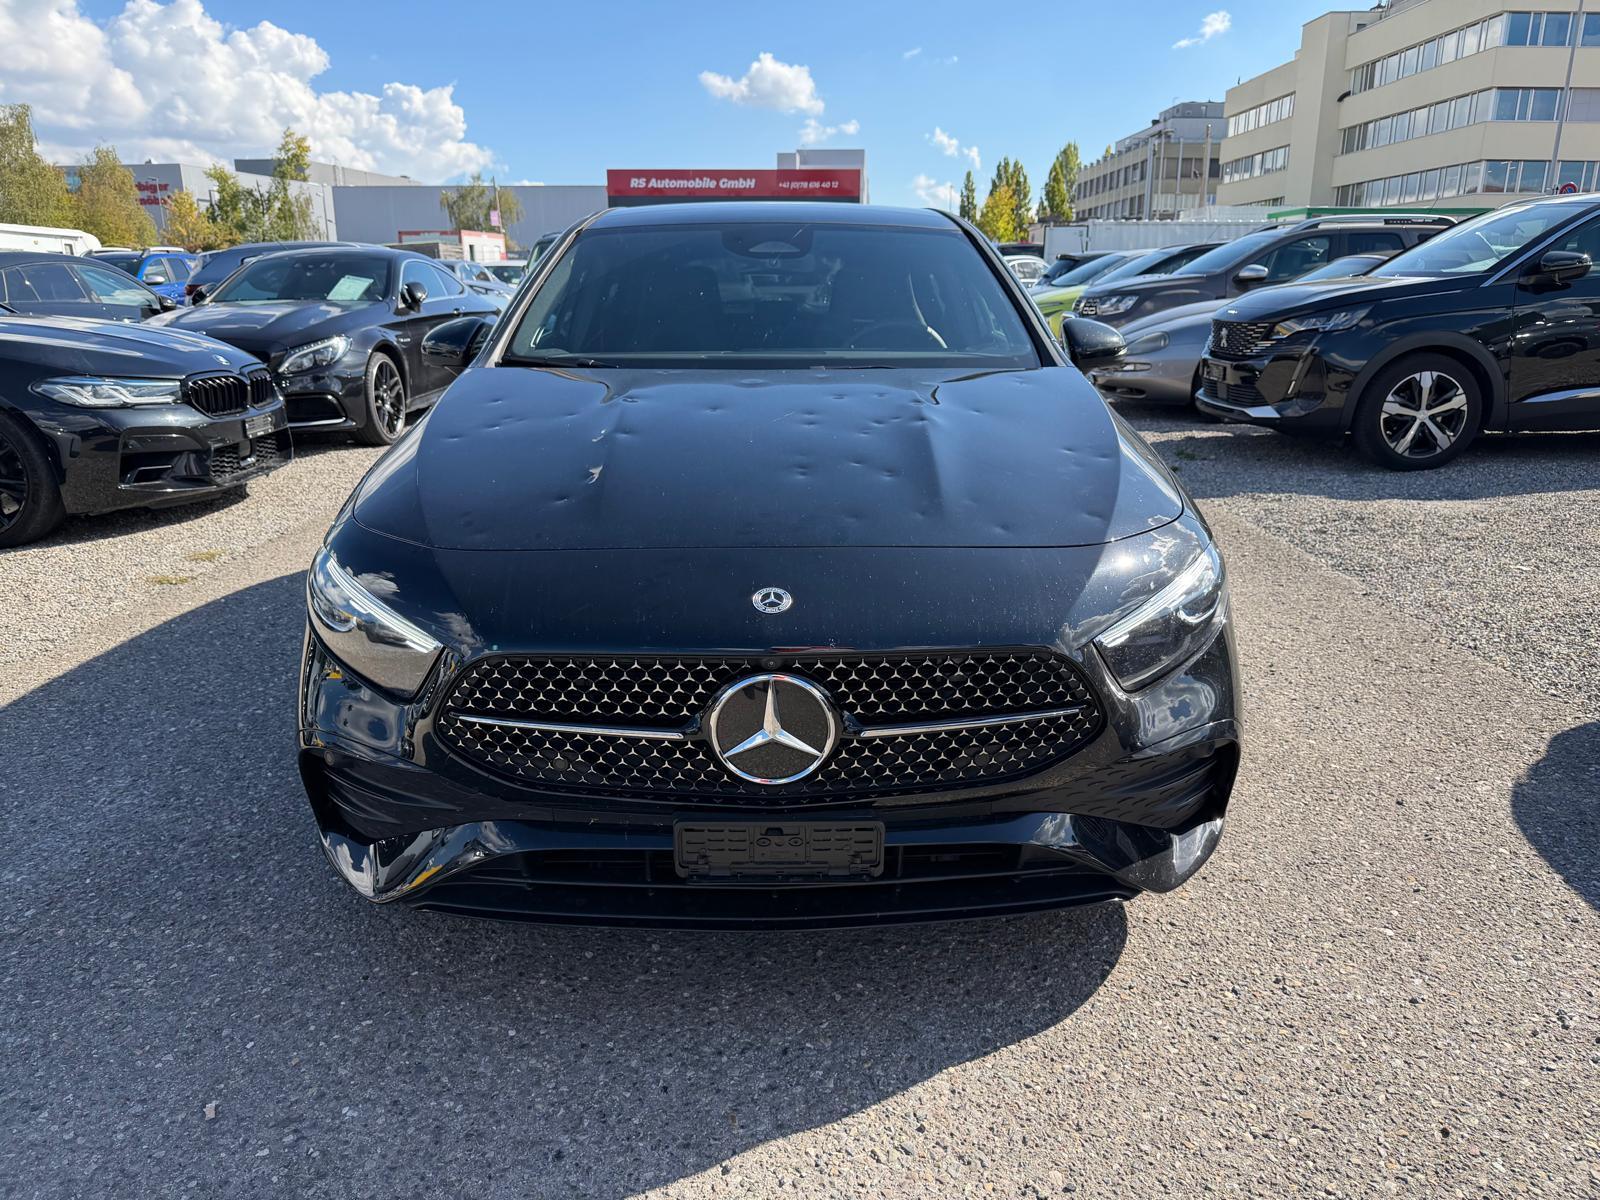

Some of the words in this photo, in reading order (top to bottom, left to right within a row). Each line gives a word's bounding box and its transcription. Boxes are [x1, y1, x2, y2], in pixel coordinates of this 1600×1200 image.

[630, 178, 647, 189] RS
[648, 177, 718, 189] Automobile
[719, 178, 756, 189] GmbH
